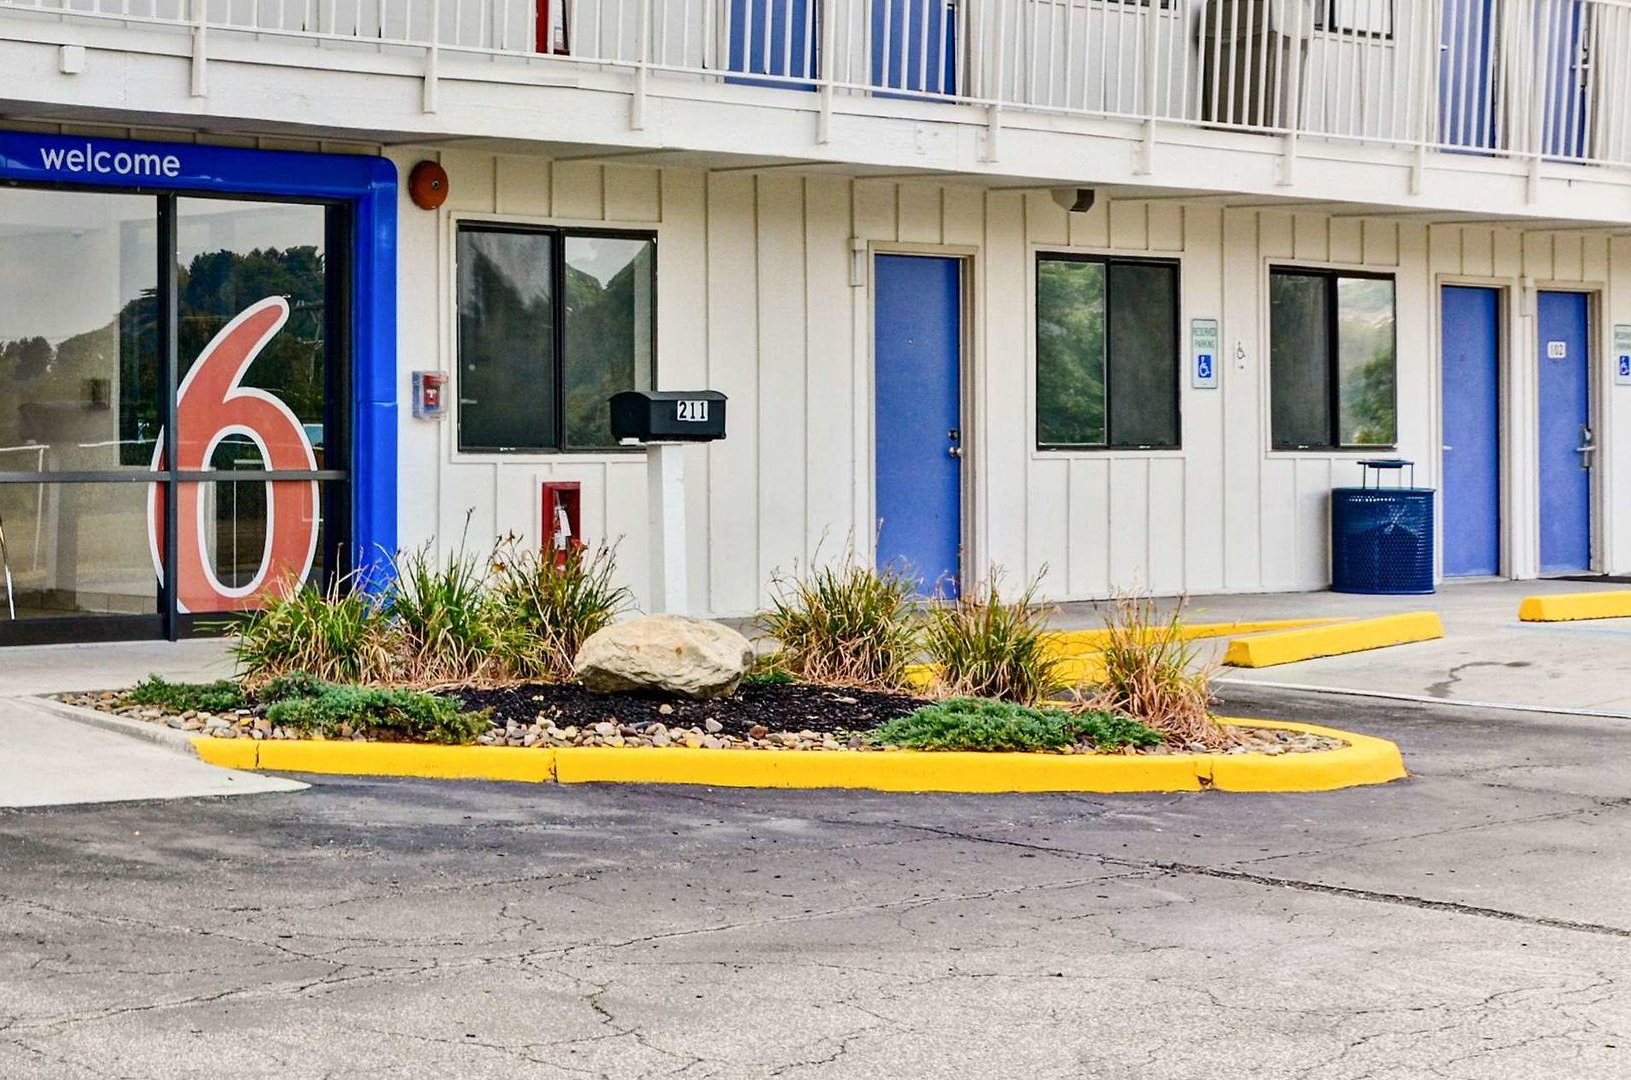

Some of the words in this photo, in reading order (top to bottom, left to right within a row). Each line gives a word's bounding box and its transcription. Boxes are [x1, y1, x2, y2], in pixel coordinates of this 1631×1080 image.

[40, 143, 181, 177] welcome
[679, 401, 706, 419] 211
[147, 295, 320, 614] 6
